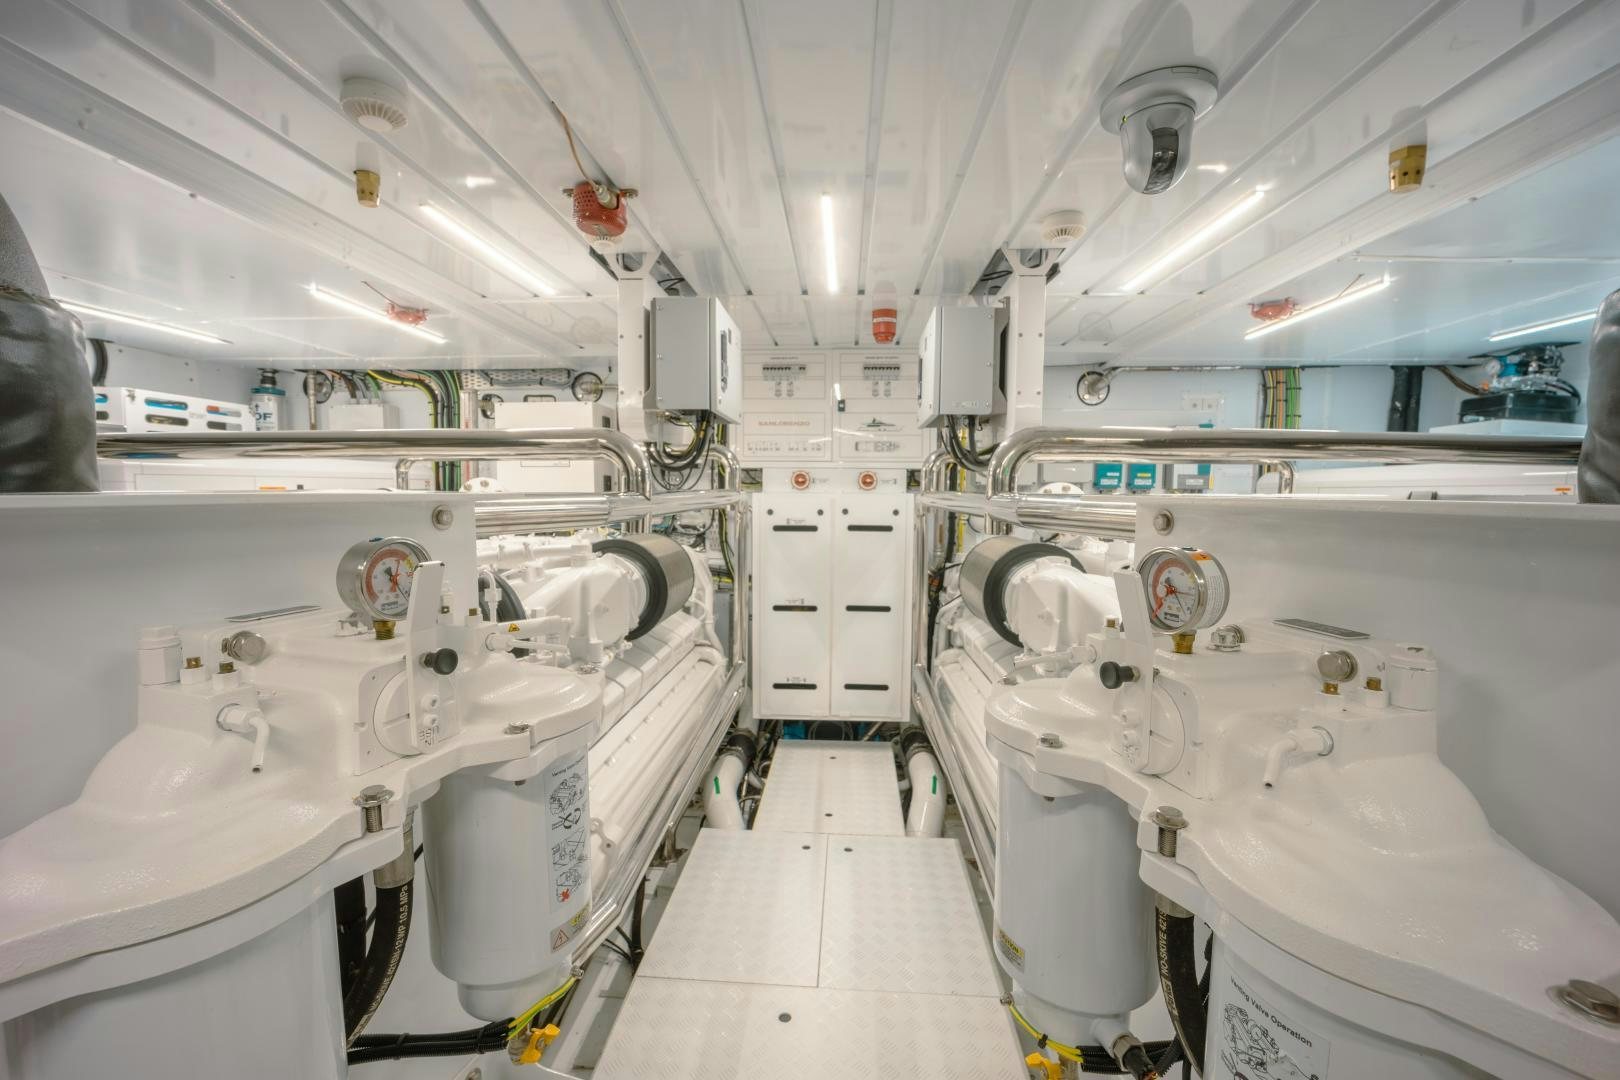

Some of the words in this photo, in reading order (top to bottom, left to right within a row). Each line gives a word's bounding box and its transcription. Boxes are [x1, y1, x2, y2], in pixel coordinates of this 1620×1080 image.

[1160, 928, 1169, 976] NO-SKIVE
[1251, 998, 1269, 1018] Valve
[1270, 1015, 1313, 1048] Operation
